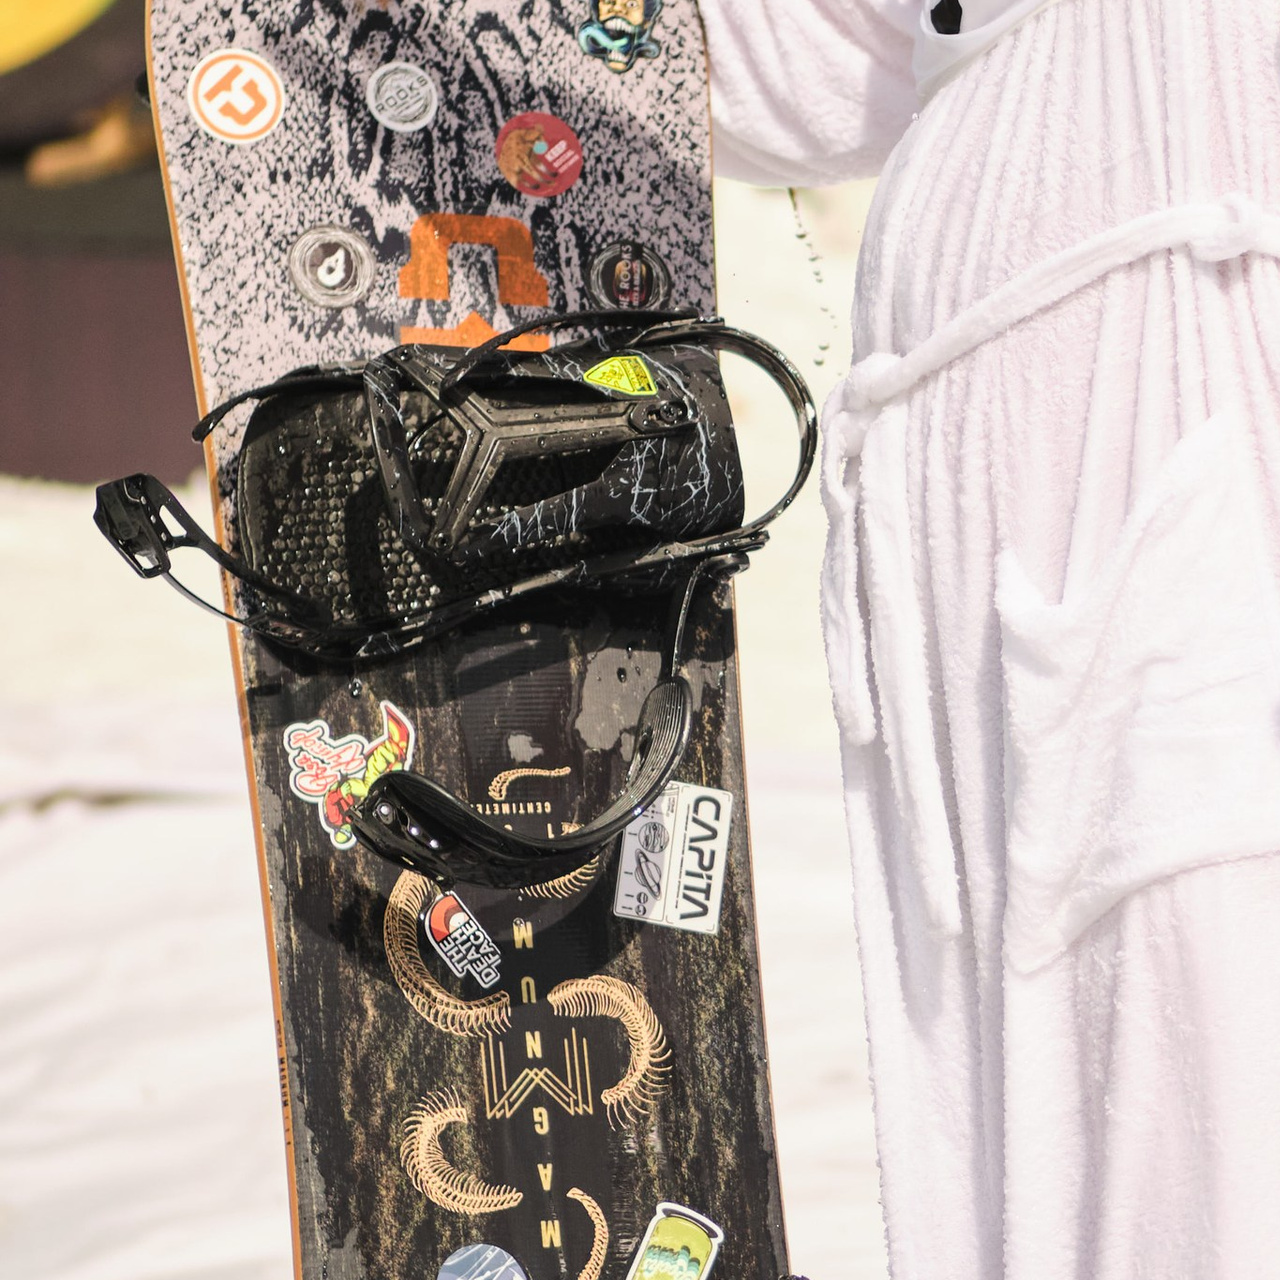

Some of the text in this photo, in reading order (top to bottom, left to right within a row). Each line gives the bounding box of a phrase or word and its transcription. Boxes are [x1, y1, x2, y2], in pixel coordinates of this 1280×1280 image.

[375, 75, 428, 113] ROOKS
[619, 244, 632, 289] ROOKS
[470, 802, 551, 816] CENTIMETE
[438, 936, 469, 976] THE
[450, 929, 500, 986] DEATH
[461, 920, 502, 966] FACE
